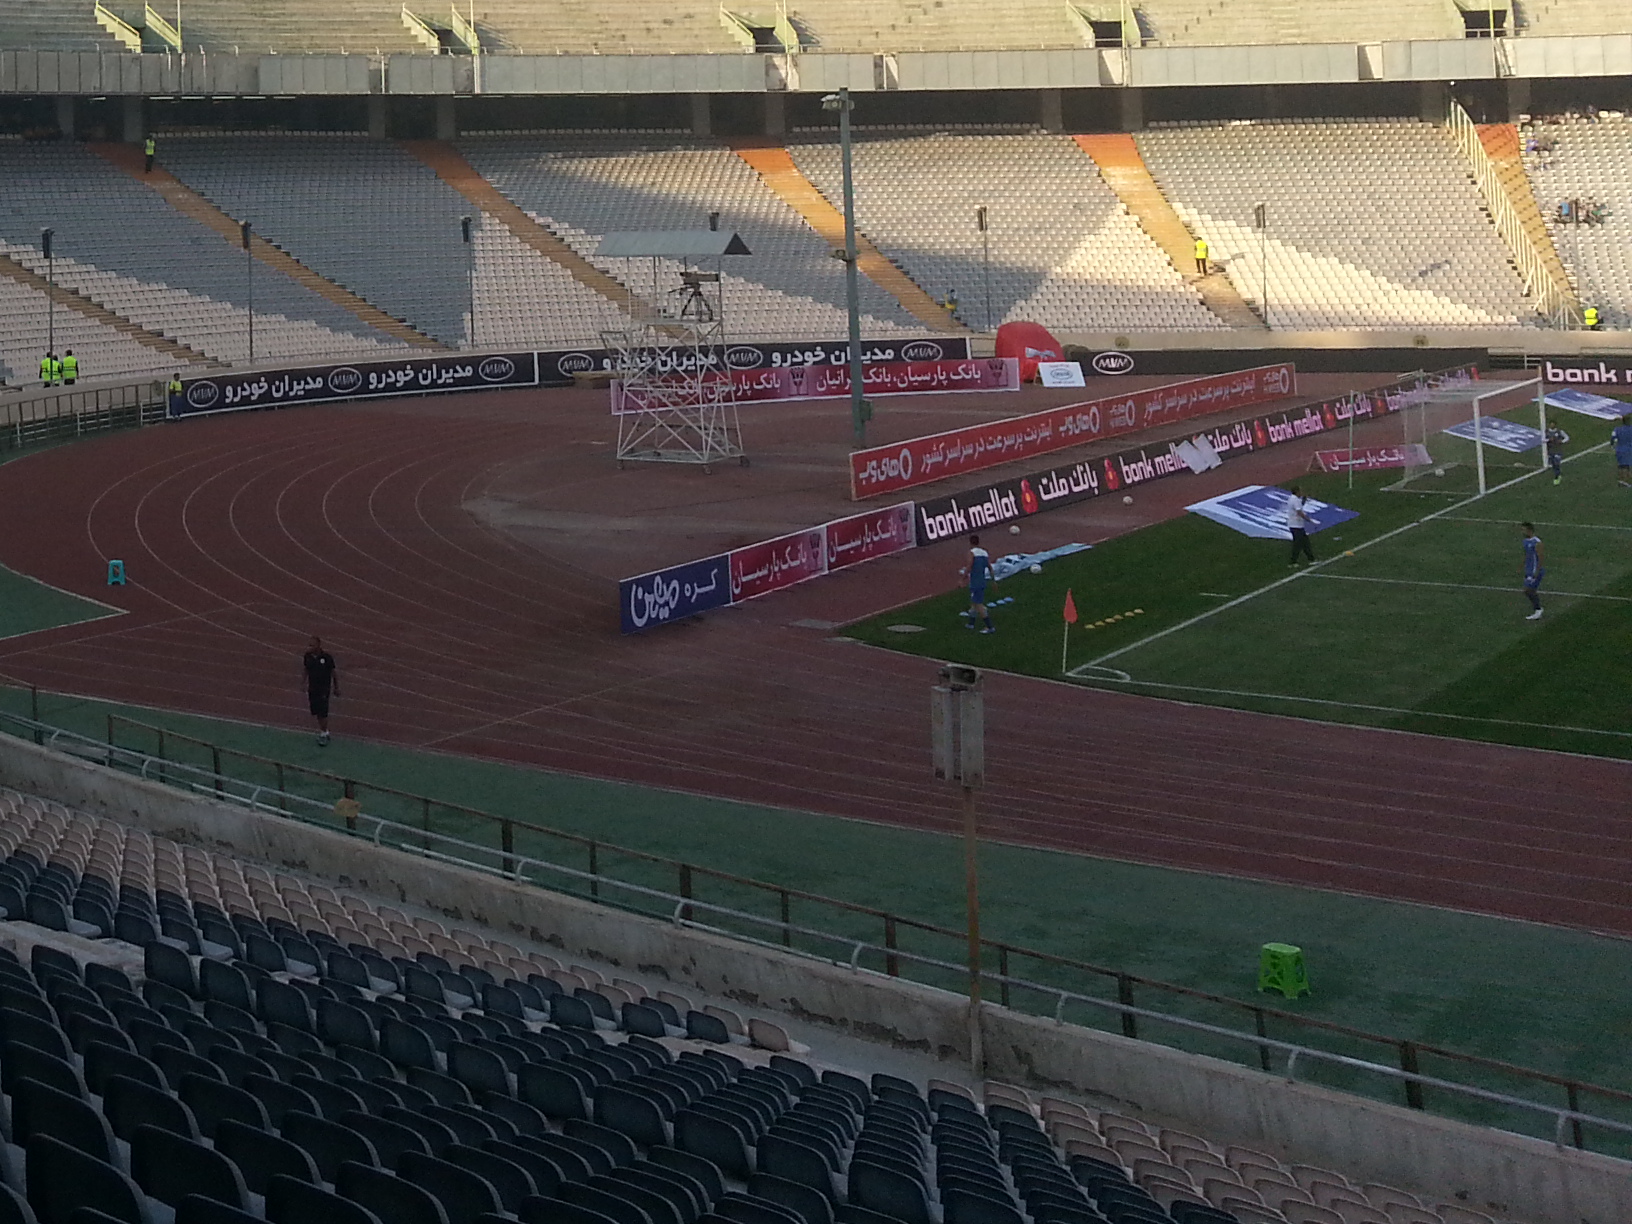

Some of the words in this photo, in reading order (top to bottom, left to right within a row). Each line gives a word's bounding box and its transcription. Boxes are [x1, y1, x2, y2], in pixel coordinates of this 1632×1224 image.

[771, 346, 826, 368] خودرو
[830, 346, 895, 365] مدیان
[368, 364, 415, 390] خودرو
[418, 364, 474, 386] مدیران
[753, 373, 781, 393] بانک
[862, 367, 891, 387] بانک
[949, 364, 981, 384] بانک
[1545, 361, 1618, 383] bank
[225, 376, 268, 403] خودرو
[271, 375, 323, 398] مدیران
[1230, 423, 1253, 451] بانک
[1266, 414, 1293, 443] bank
[1293, 408, 1324, 435] mellat
[1119, 450, 1155, 484] bank
[1154, 442, 1188, 475] mell
[1038, 471, 1069, 501] ملت
[1069, 462, 1099, 495] بانک
[921, 499, 968, 540] bank
[968, 488, 1018, 527] mellat
[684, 569, 718, 604] کره
